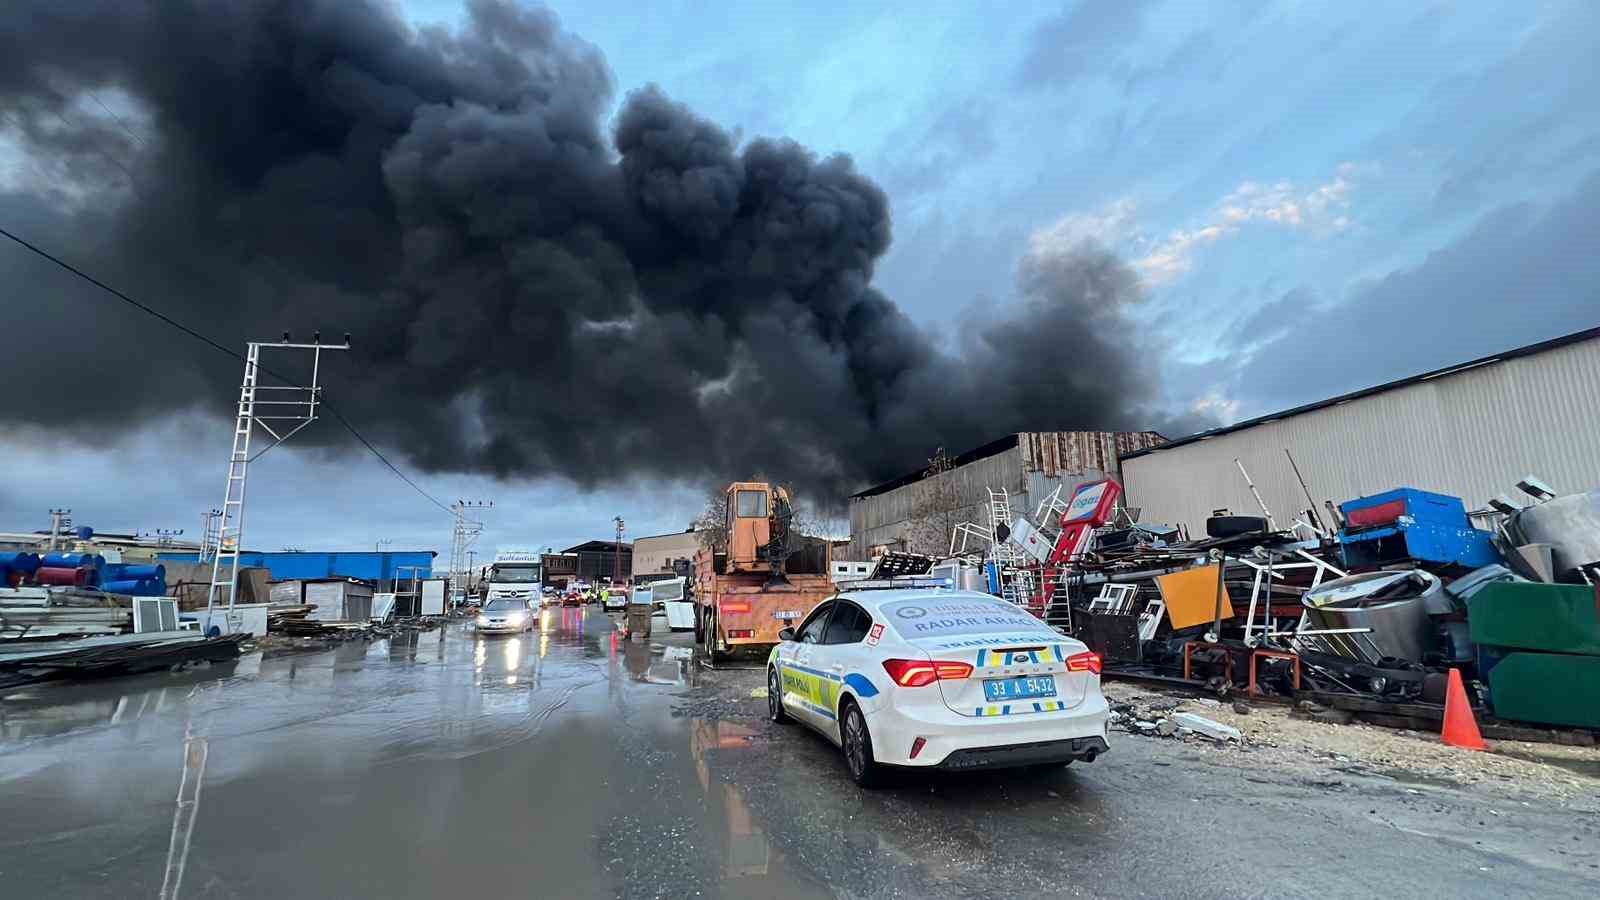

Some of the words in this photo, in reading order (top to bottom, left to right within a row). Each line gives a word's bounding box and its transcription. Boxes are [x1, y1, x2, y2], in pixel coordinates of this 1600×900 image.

[915, 617, 979, 631] RADAR
[991, 682, 1006, 696] 33
[1014, 681, 1021, 693] A
[1026, 678, 1053, 693] 5432
